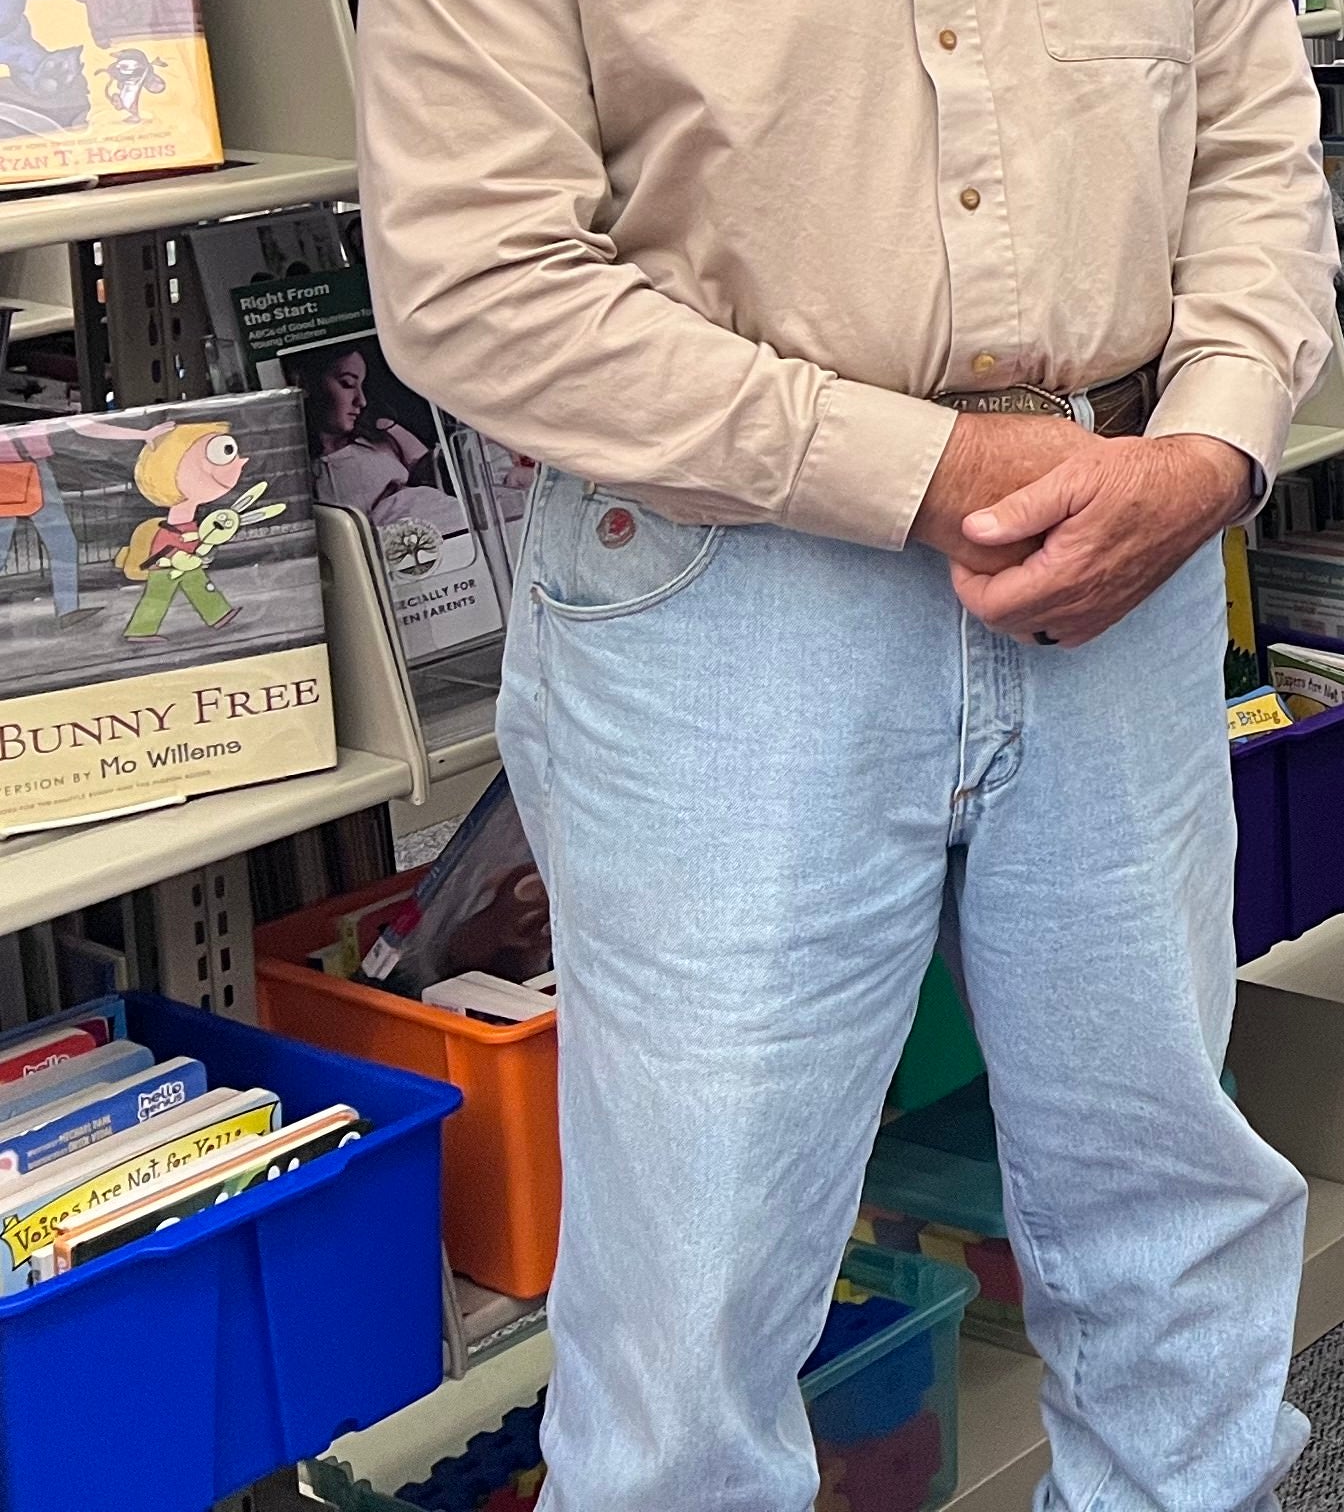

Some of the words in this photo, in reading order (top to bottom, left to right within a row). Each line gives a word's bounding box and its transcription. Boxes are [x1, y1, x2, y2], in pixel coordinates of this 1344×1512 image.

[86, 144, 176, 164] HIGGINS
[240, 292, 283, 310] Right
[287, 284, 330, 300] From
[243, 313, 271, 326] the
[274, 302, 318, 320] Start:
[284, 328, 327, 343] Children
[977, 392, 1034, 413] ARENA
[453, 579, 476, 593] FOR
[1275, 670, 1307, 689] Diapers
[0, 703, 176, 761] BUNNY
[192, 678, 321, 725] FREE
[1237, 707, 1281, 728] Biting
[73, 771, 91, 785] BY
[100, 756, 137, 779] Mo
[146, 740, 242, 769] Willems
[139, 1081, 183, 1108] hello
[139, 1093, 185, 1121] genius
[87, 1186, 121, 1209] Are
[127, 1158, 161, 1191] Not
[167, 1154, 191, 1172] for
